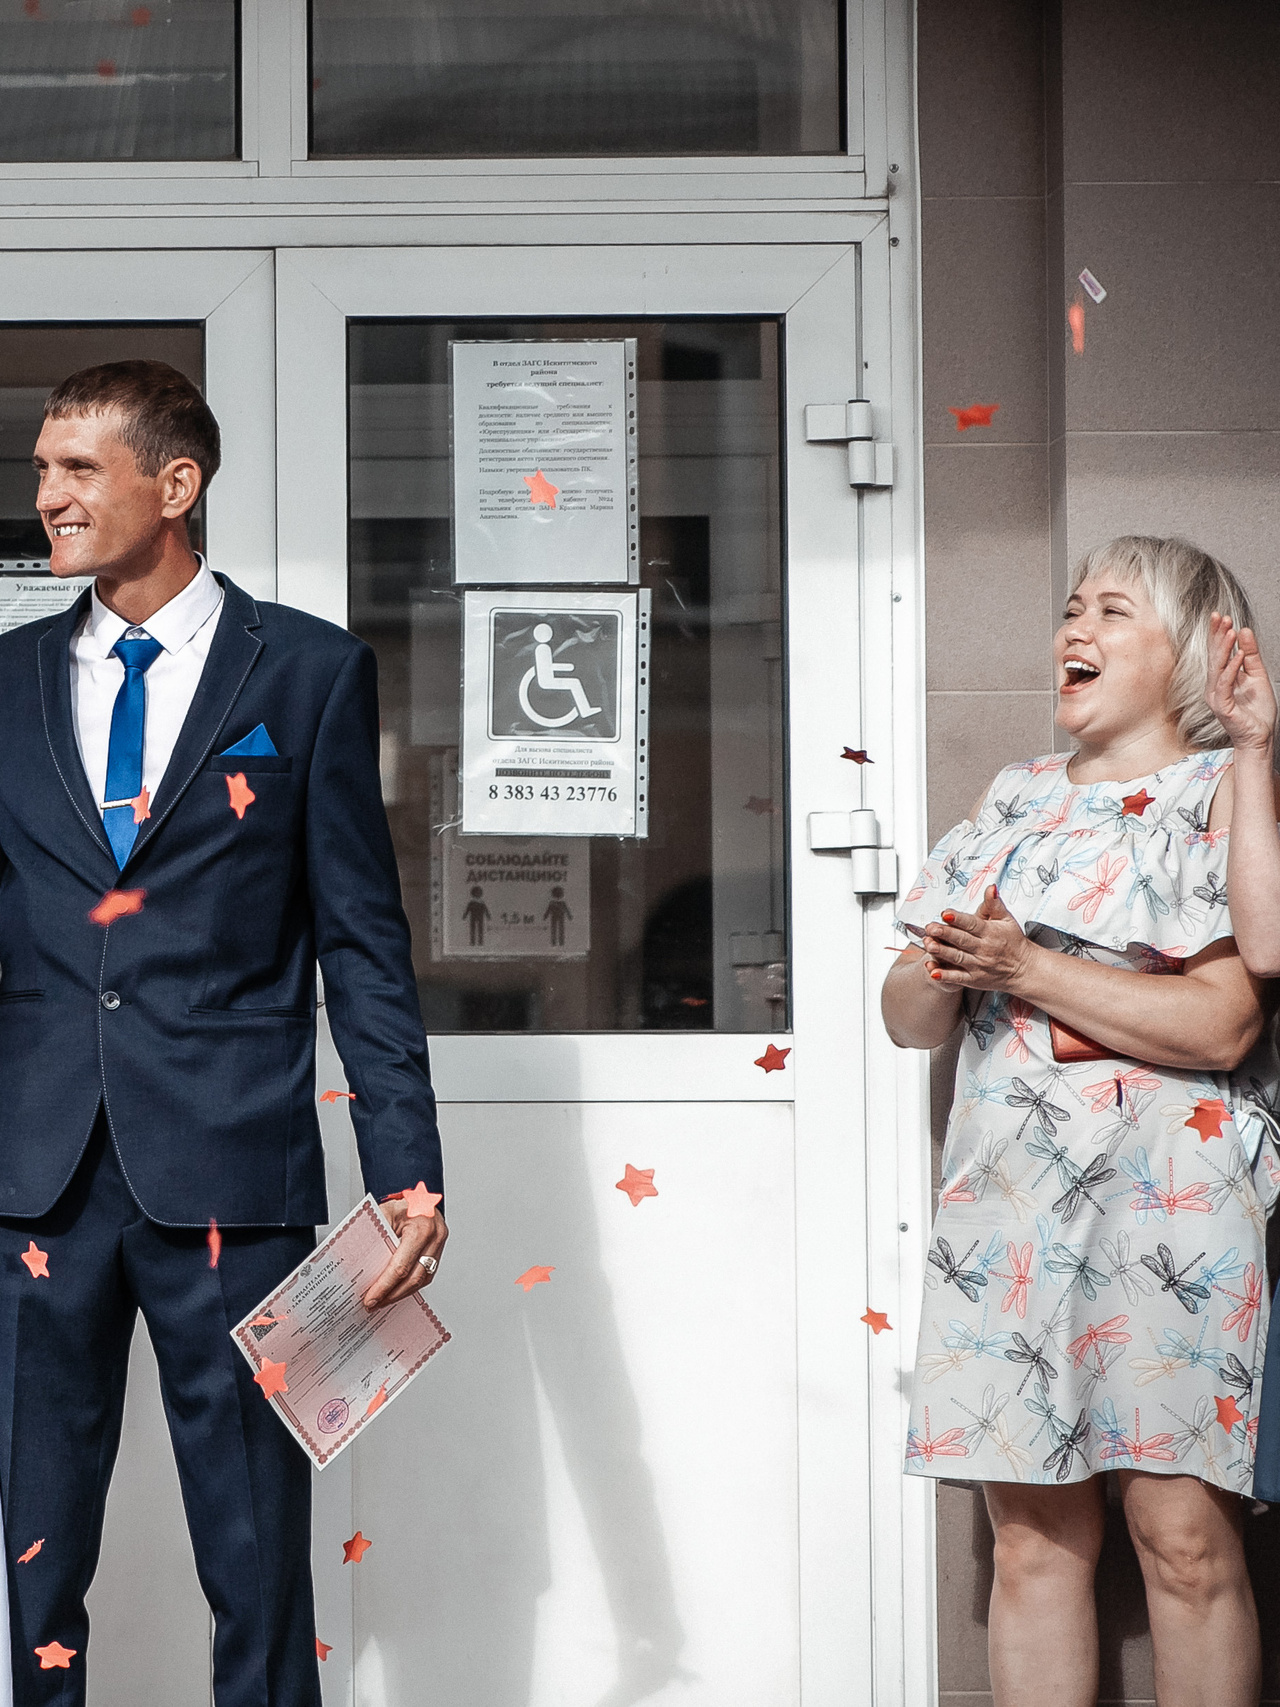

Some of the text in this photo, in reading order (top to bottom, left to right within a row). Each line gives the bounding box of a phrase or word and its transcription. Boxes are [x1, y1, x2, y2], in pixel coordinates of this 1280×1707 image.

[16, 583, 70, 592] Уважаемые
[539, 758, 589, 766] Искитимского
[489, 785, 617, 802] 8 383 43 23776
[465, 851, 569, 866] СОБЛЮДАЙТЕ
